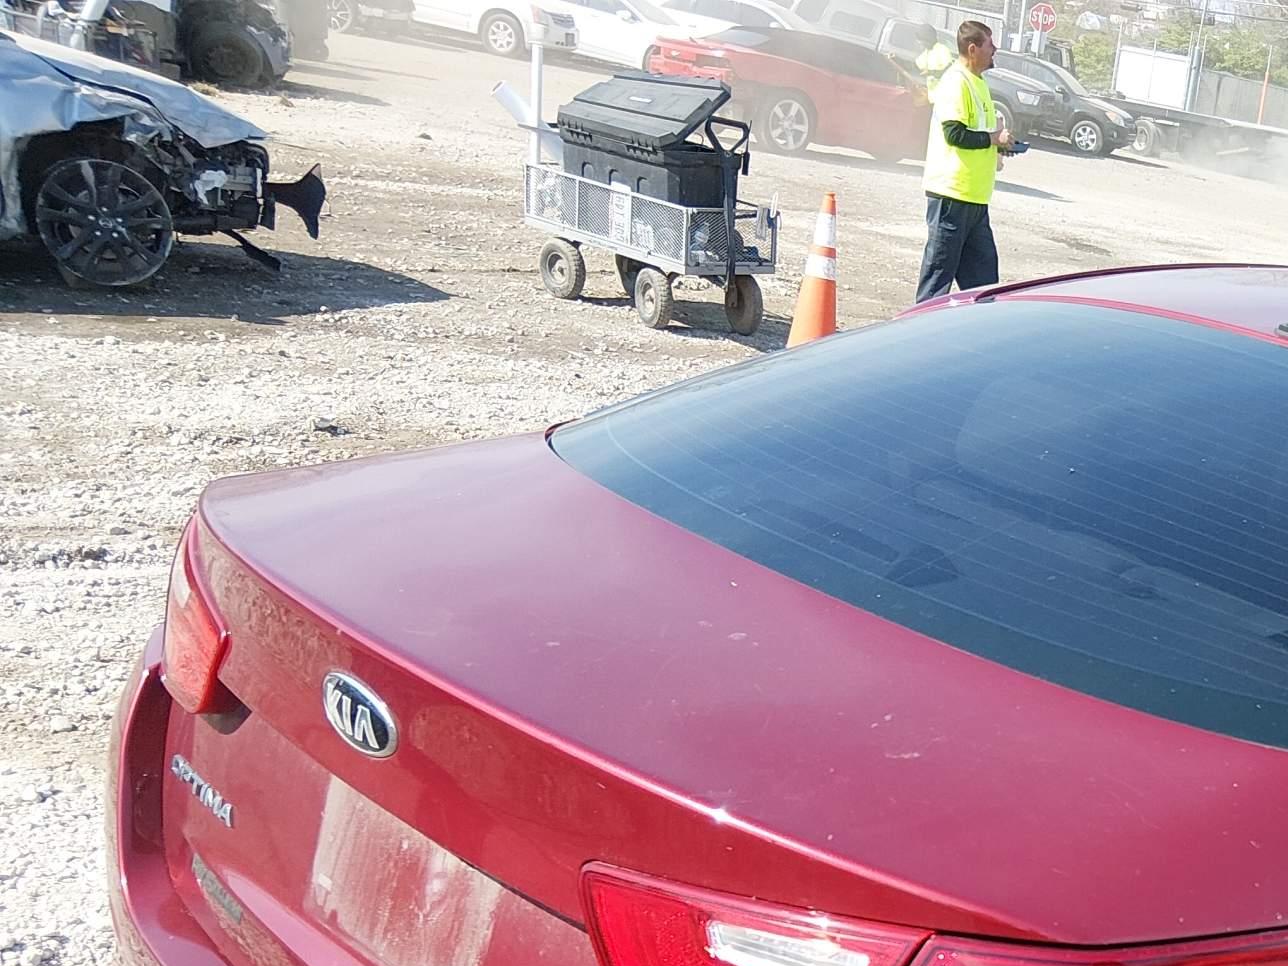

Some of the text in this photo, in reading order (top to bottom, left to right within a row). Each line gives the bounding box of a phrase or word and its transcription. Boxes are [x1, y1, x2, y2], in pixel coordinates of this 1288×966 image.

[1031, 10, 1055, 25] STOP
[326, 682, 380, 749] KIA
[171, 754, 233, 829] OPTIMA
